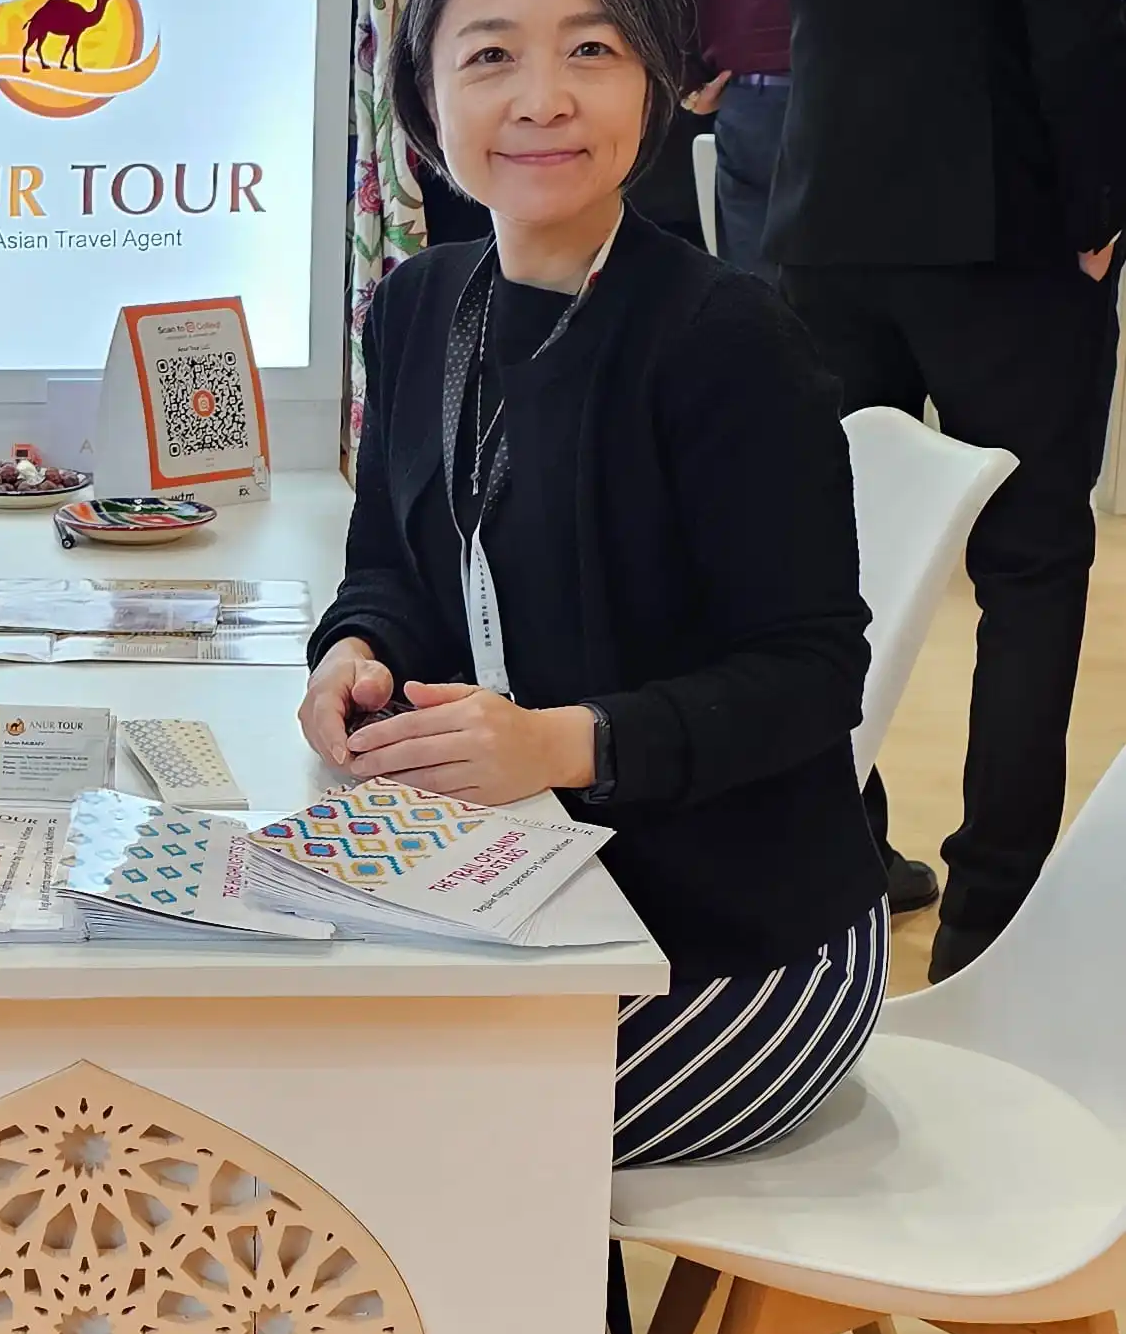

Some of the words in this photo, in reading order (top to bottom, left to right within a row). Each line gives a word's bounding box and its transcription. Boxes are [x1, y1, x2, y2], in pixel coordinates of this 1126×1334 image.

[71, 161, 267, 216] TOUR
[54, 230, 118, 250] Travel
[123, 229, 183, 253] Agent
[29, 720, 56, 730] ANUR
[57, 721, 84, 731] TOUR
[550, 824, 595, 836] TOUR
[428, 876, 458, 893] THE
[447, 861, 484, 882] TRAIL
[474, 851, 495, 865] OF
[487, 831, 526, 854] SANDS
[471, 868, 500, 886] AND
[490, 848, 530, 870] STARS
